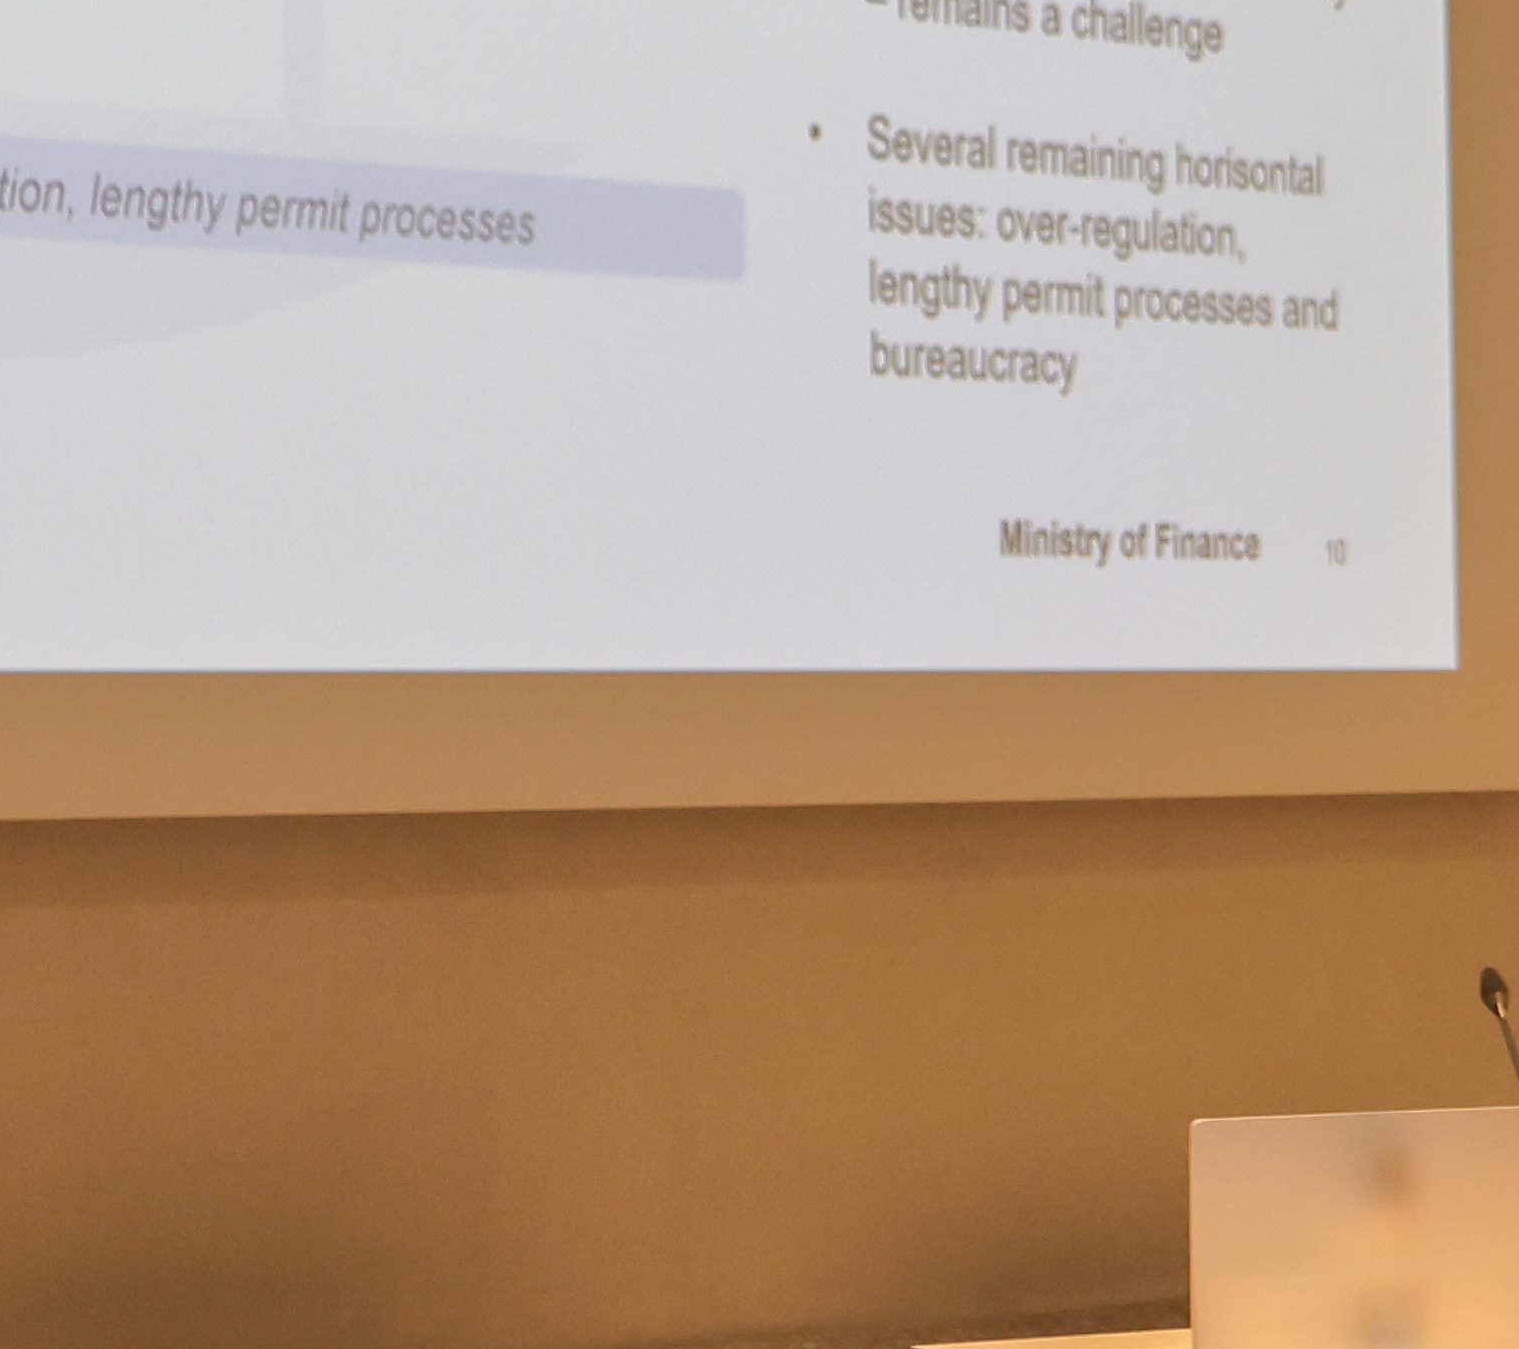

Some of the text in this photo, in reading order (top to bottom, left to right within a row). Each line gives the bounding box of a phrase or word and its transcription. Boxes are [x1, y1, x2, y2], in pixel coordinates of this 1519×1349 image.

[1041, 2, 1061, 36] a
[868, 113, 1324, 195] Several remaining horisontal
[90, 172, 227, 235] lengthy
[235, 189, 351, 237] permit
[358, 200, 536, 247] processes
[869, 184, 1244, 261] issues: over-regulation,
[869, 259, 1338, 330] lengthy permit processes and
[871, 330, 1077, 396] bureaucracy
[1000, 519, 1260, 567] Ministry of Finance
